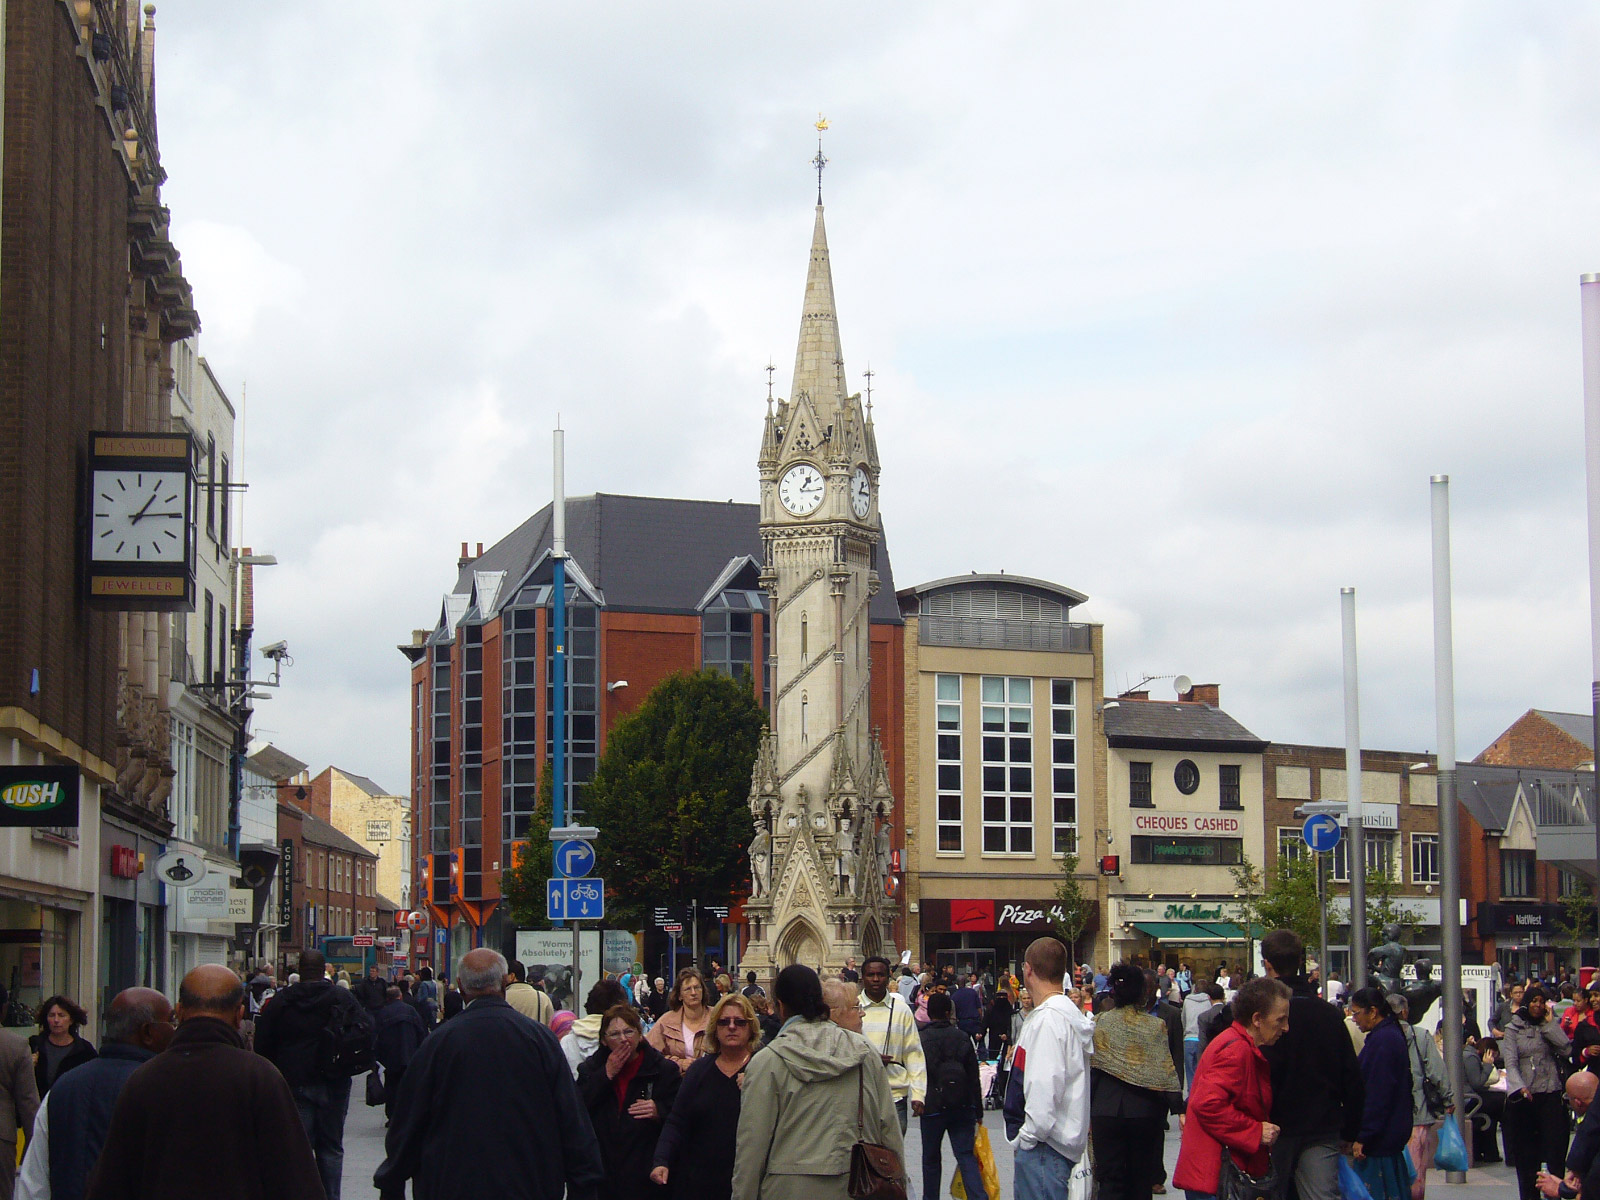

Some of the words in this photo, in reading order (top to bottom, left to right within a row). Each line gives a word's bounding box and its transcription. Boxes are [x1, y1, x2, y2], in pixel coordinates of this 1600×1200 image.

[102, 581, 173, 591] JEWELLER
[5, 782, 60, 804] LUSH
[1136, 816, 1188, 831] CHEQUES
[1194, 818, 1239, 831] CASHED
[283, 898, 291, 927] SHOP
[998, 904, 1045, 926] Pizza
[1164, 904, 1222, 919] Mallard
[1515, 914, 1542, 925] NatWest
[605, 938, 633, 946] Exclusive
[521, 949, 567, 958] Absolutely
